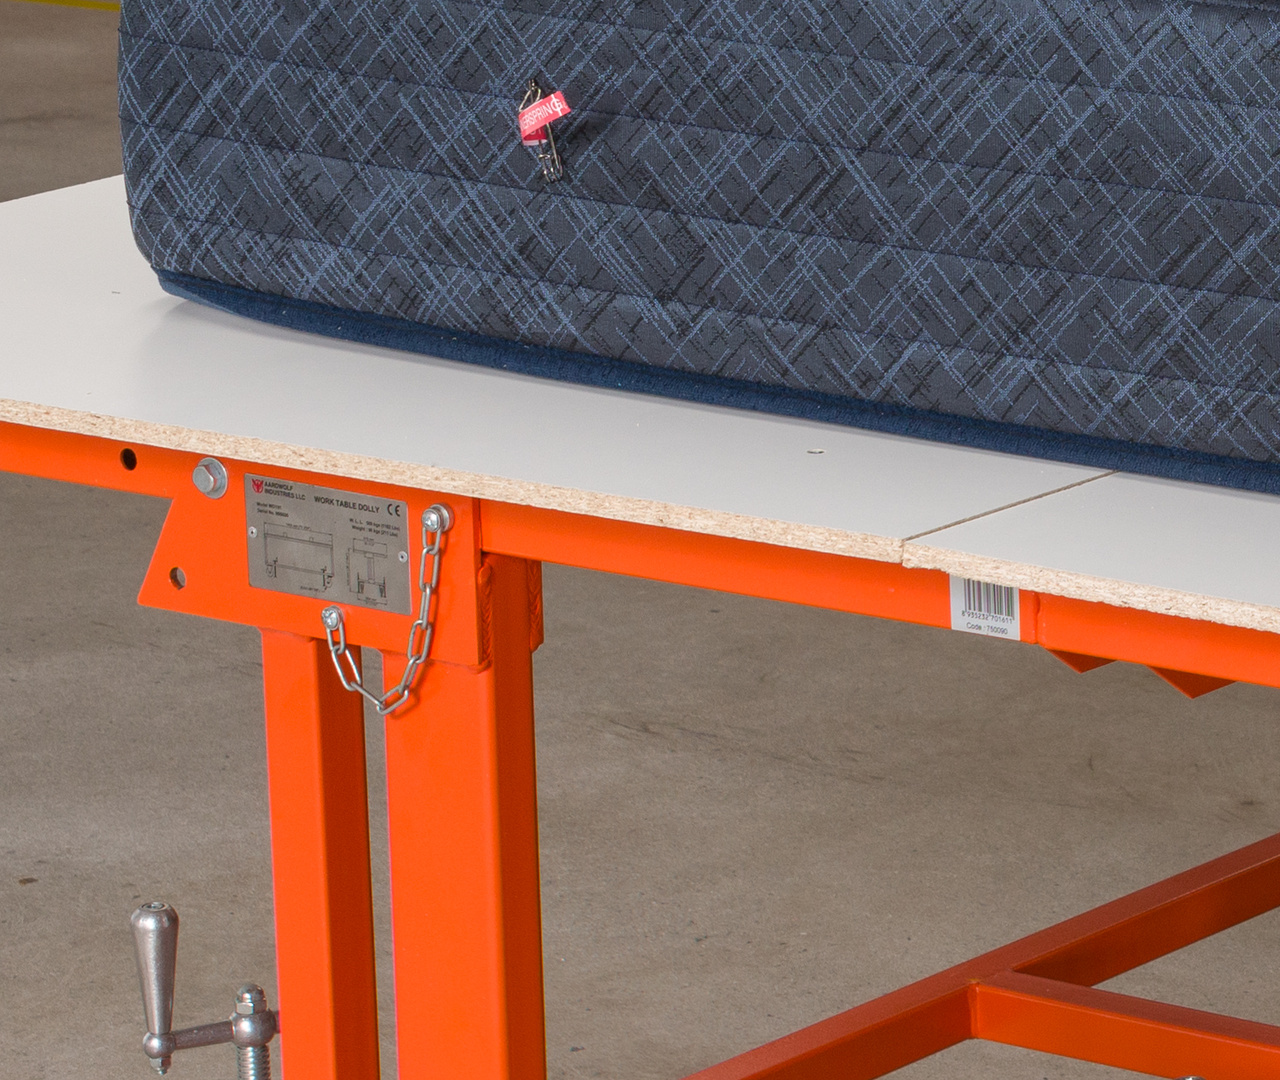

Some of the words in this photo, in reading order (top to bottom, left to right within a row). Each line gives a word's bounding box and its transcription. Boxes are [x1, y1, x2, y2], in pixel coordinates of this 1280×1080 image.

[264, 481, 293, 491] AARDWOLF
[264, 488, 295, 499] INDUSTRIES
[314, 495, 335, 506] WORK
[335, 499, 357, 510] TABLE
[358, 503, 380, 513] DOLLY
[966, 621, 982, 630] Code
